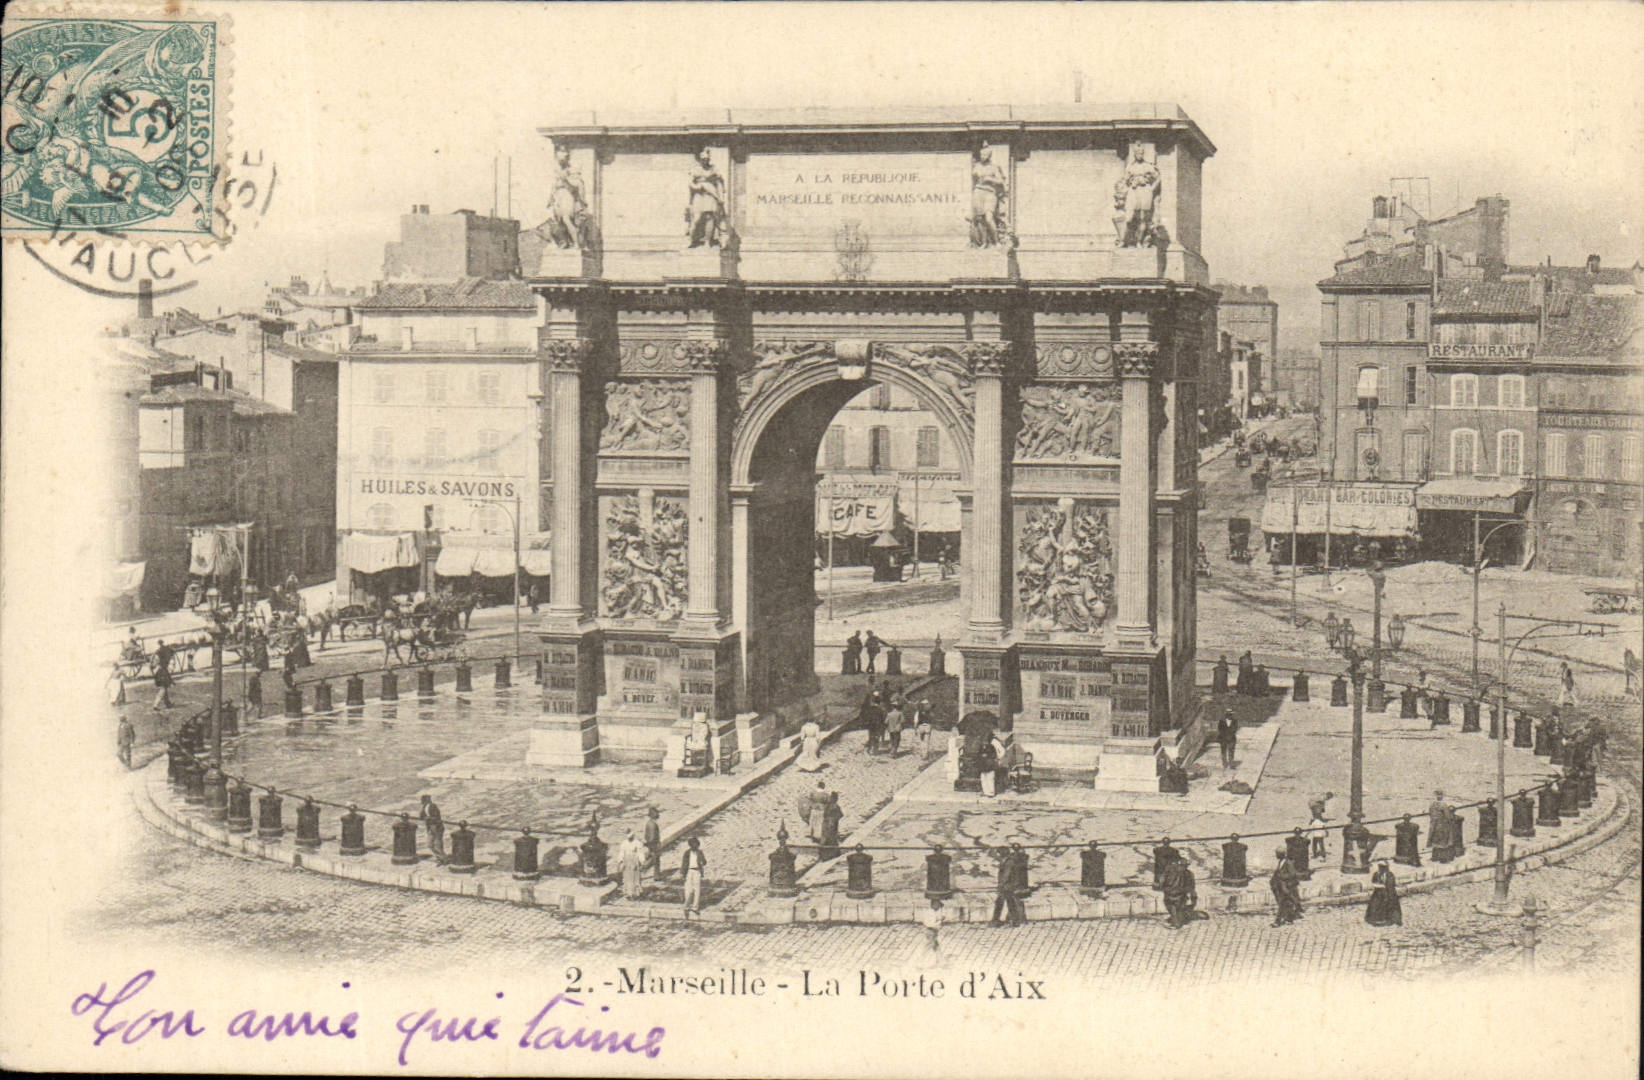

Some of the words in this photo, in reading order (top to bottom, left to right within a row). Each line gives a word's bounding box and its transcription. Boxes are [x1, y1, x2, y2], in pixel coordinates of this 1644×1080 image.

[188, 83, 211, 174] POSTES
[814, 173, 833, 183] LA
[756, 194, 834, 205] MARSEILLE
[1432, 344, 1524, 357] RESTAURANT
[361, 479, 427, 496] HUILES
[429, 486, 438, 496] &
[440, 481, 515, 498] SAVONS
[833, 503, 877, 521] CAFE
[227, 981, 359, 1041] amie
[396, 991, 504, 1066] qui
